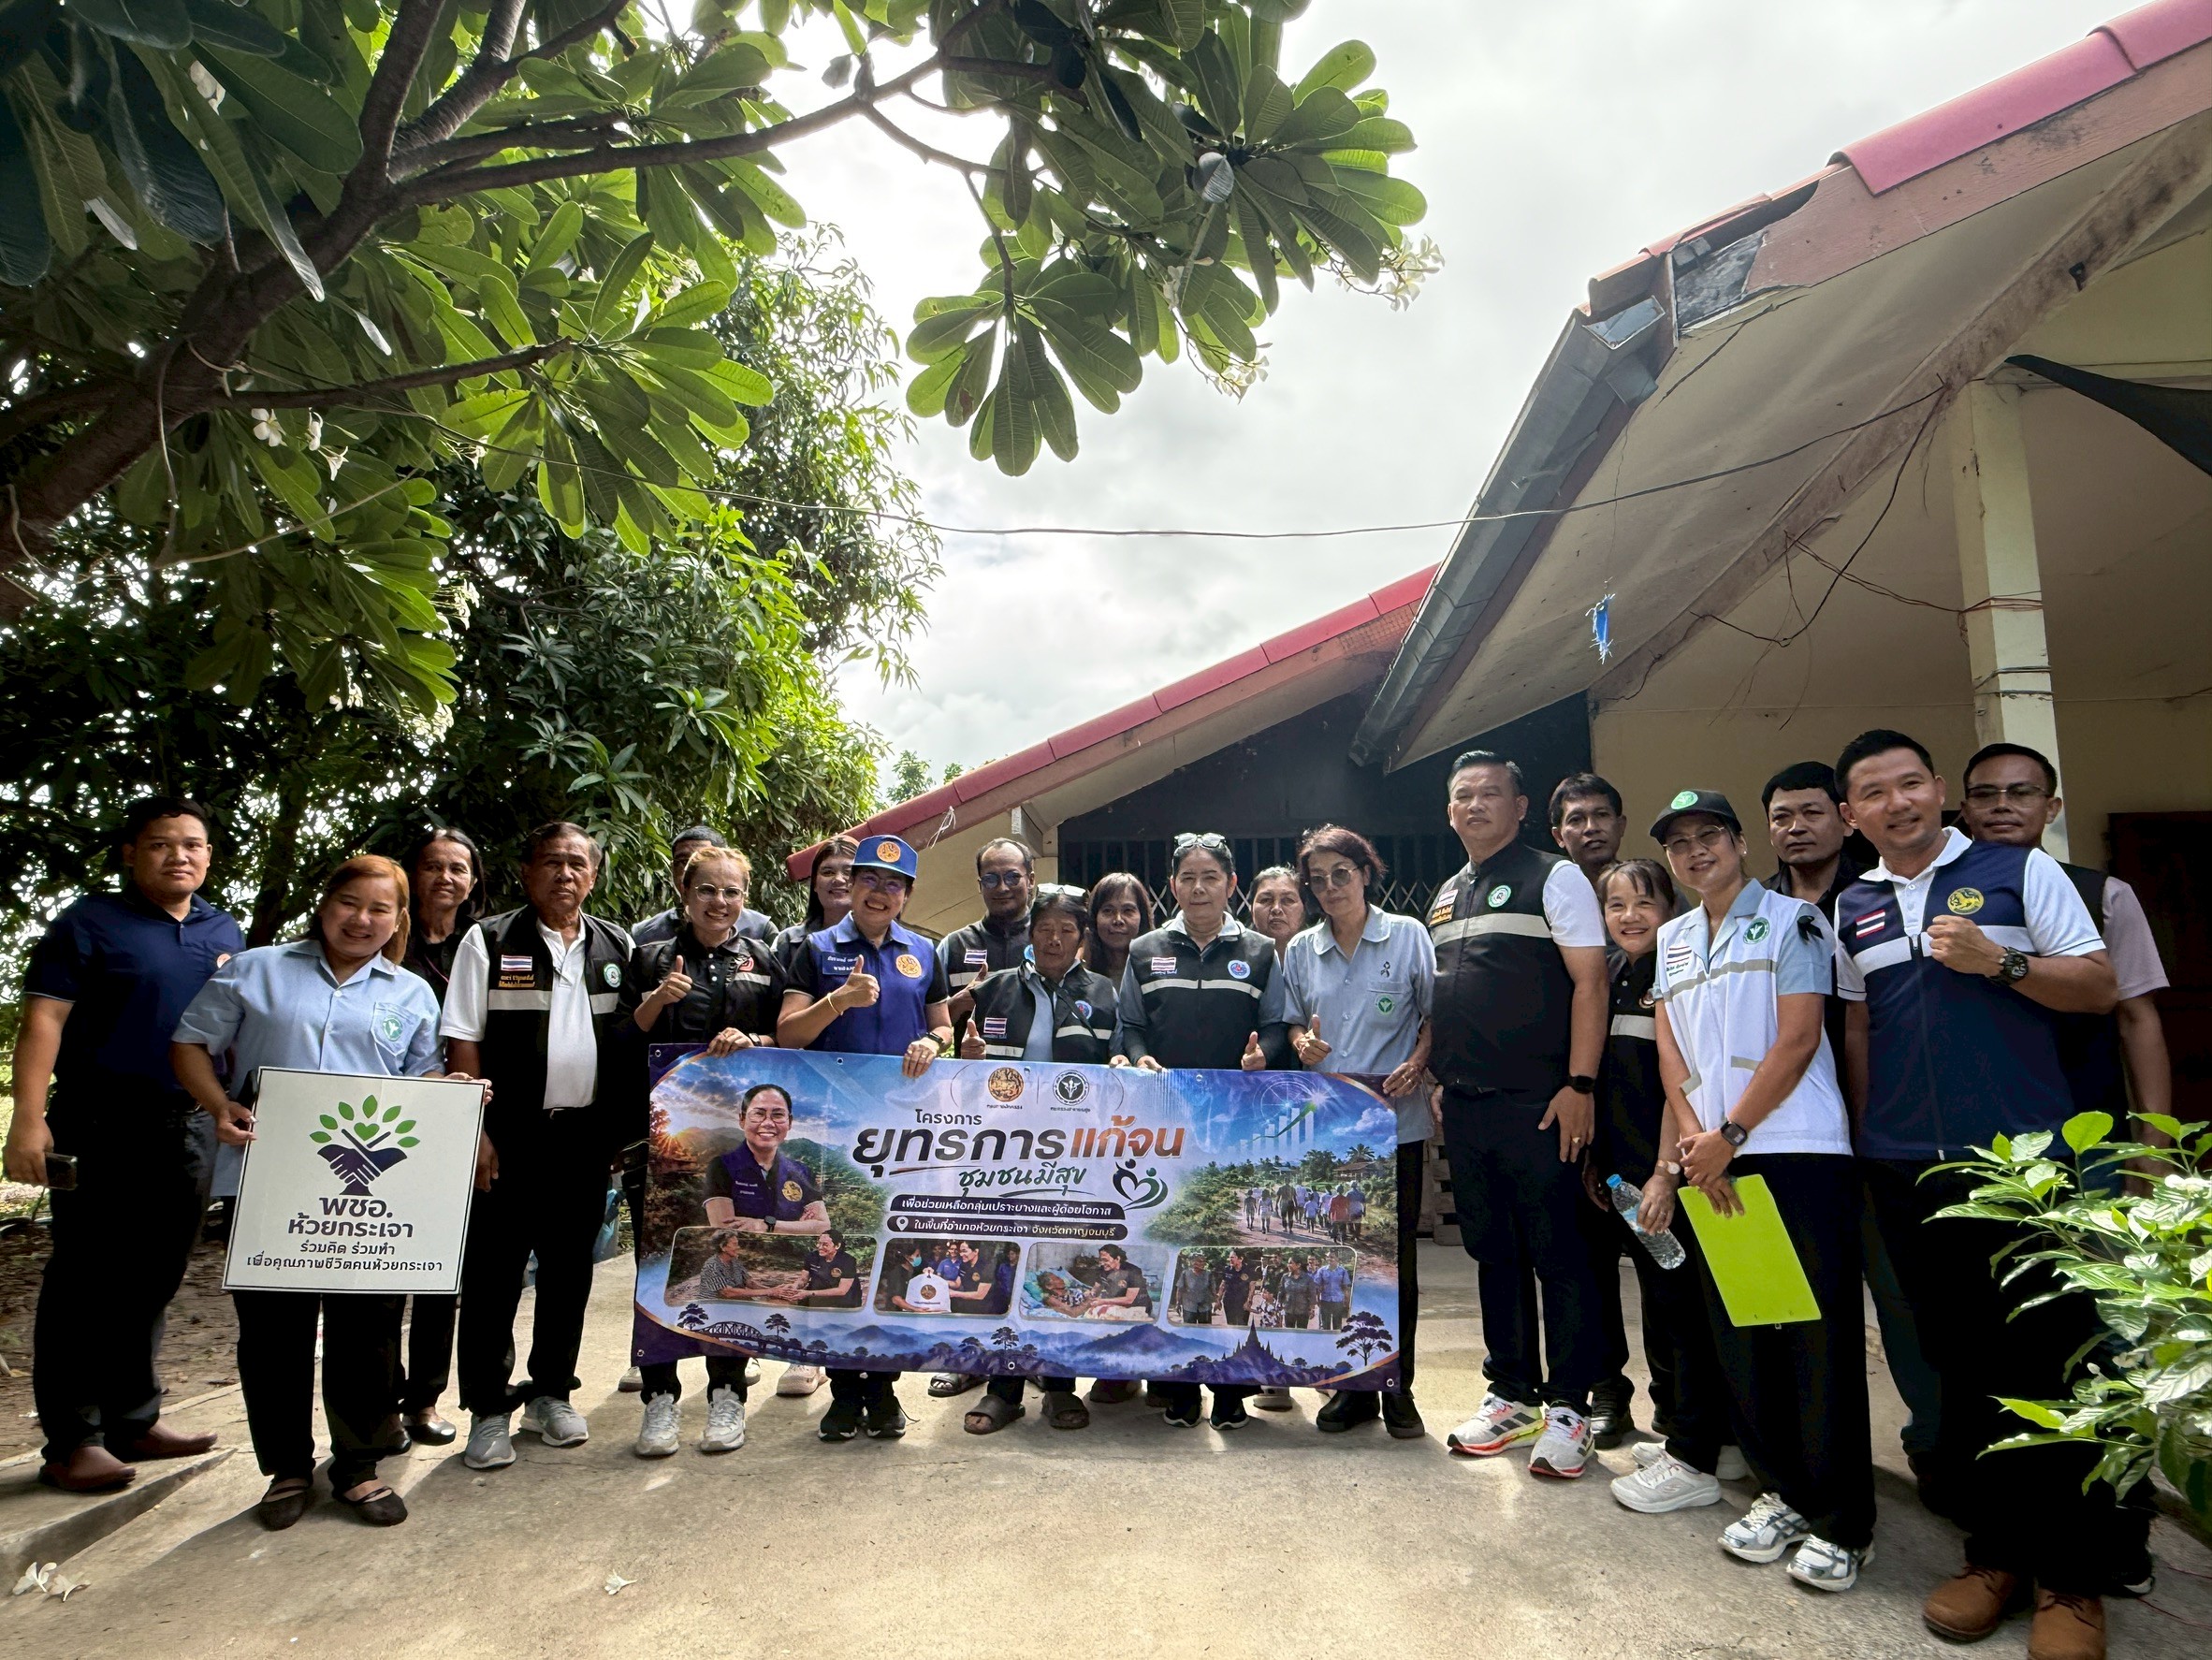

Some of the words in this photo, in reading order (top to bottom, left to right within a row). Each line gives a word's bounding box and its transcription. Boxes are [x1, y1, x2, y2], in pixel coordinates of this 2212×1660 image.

[915, 1109, 982, 1126] โครงการ
[958, 1160, 1087, 1198] ชุมชนมีสุข
[319, 1197, 393, 1218] พชอ.
[288, 1212, 414, 1238] ห้วยกระเจา
[299, 1240, 347, 1255] ร่วมคิด
[351, 1242, 396, 1256] ร่วมทำ
[247, 1250, 443, 1272] เพื่อคุณภาพชีวิตคนห้วยกระเจา
